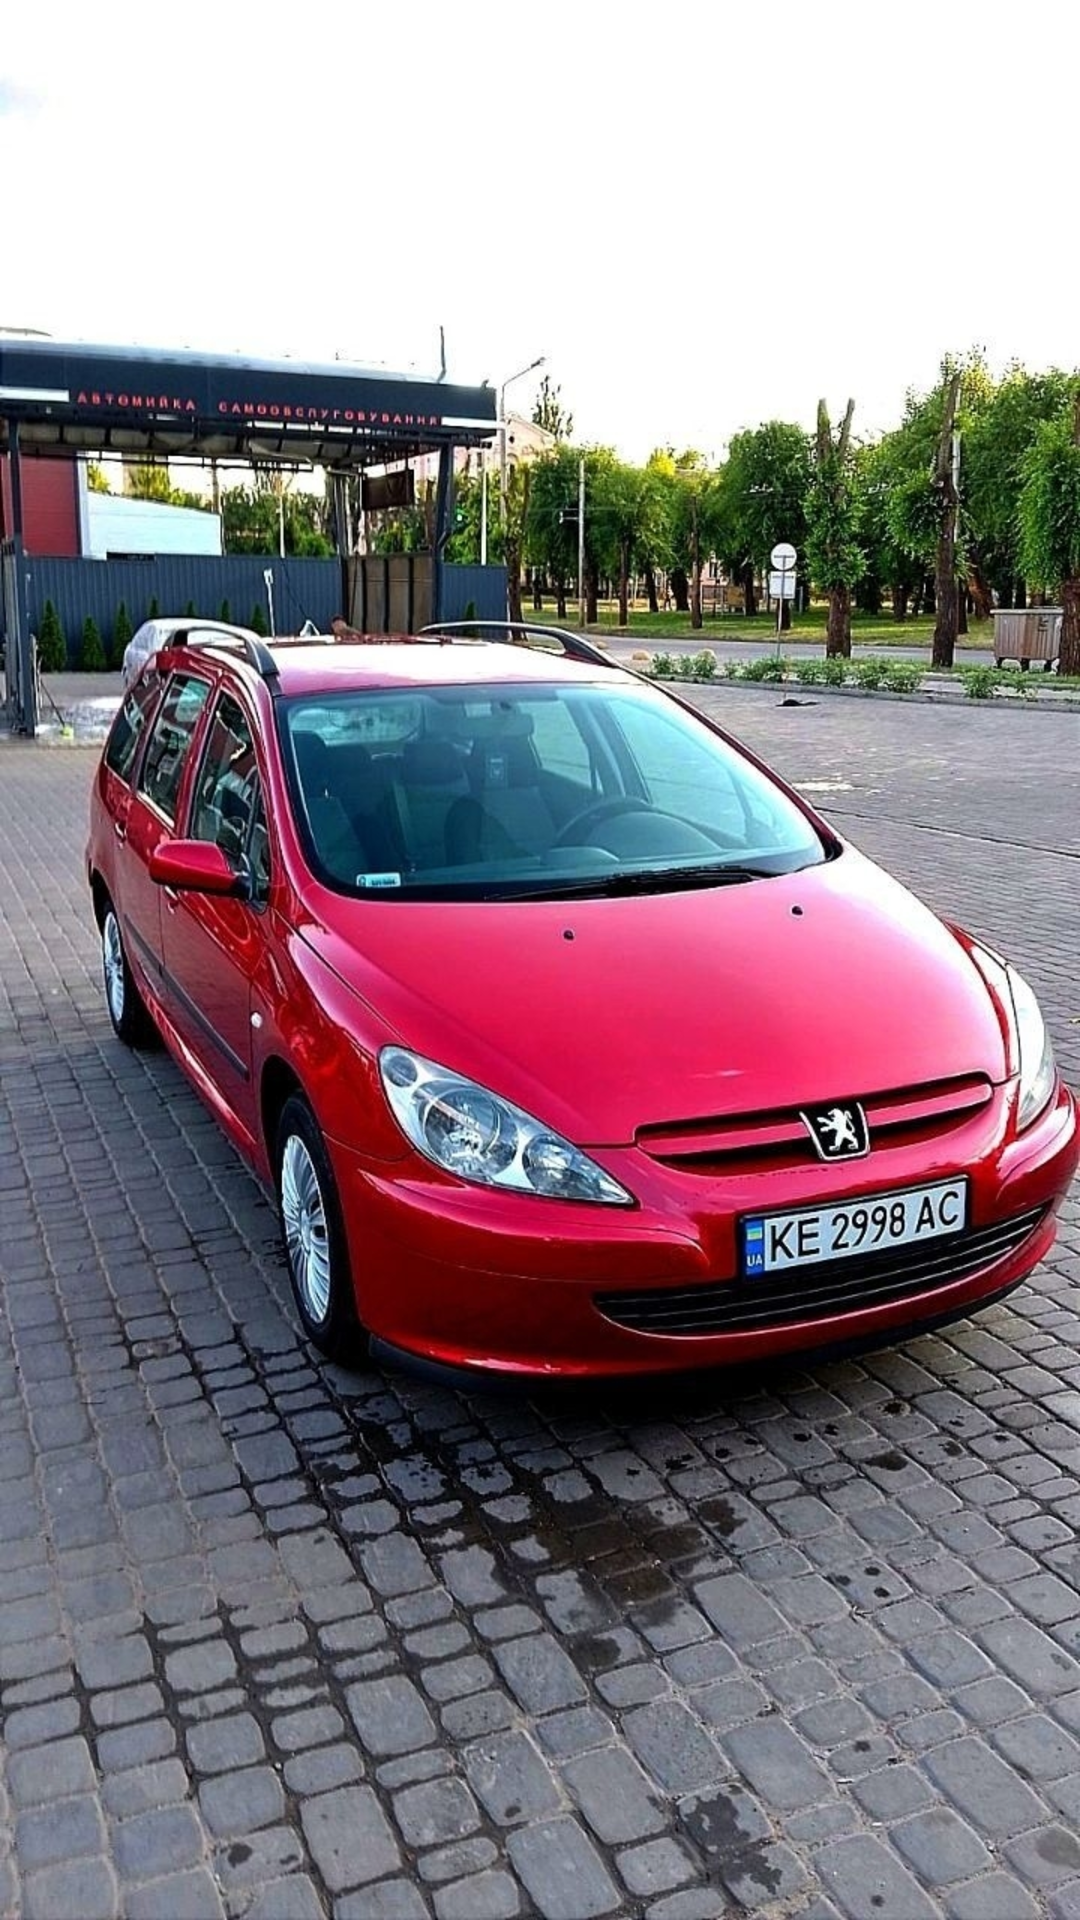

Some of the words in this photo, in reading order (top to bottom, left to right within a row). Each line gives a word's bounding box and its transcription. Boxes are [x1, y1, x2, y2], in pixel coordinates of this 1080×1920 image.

[77, 391, 196, 411] АВТОМИЙКА
[770, 1217, 820, 1262] KE
[831, 1202, 906, 1250] 2998
[915, 1191, 959, 1233] AC
[746, 1254, 763, 1267] UA
